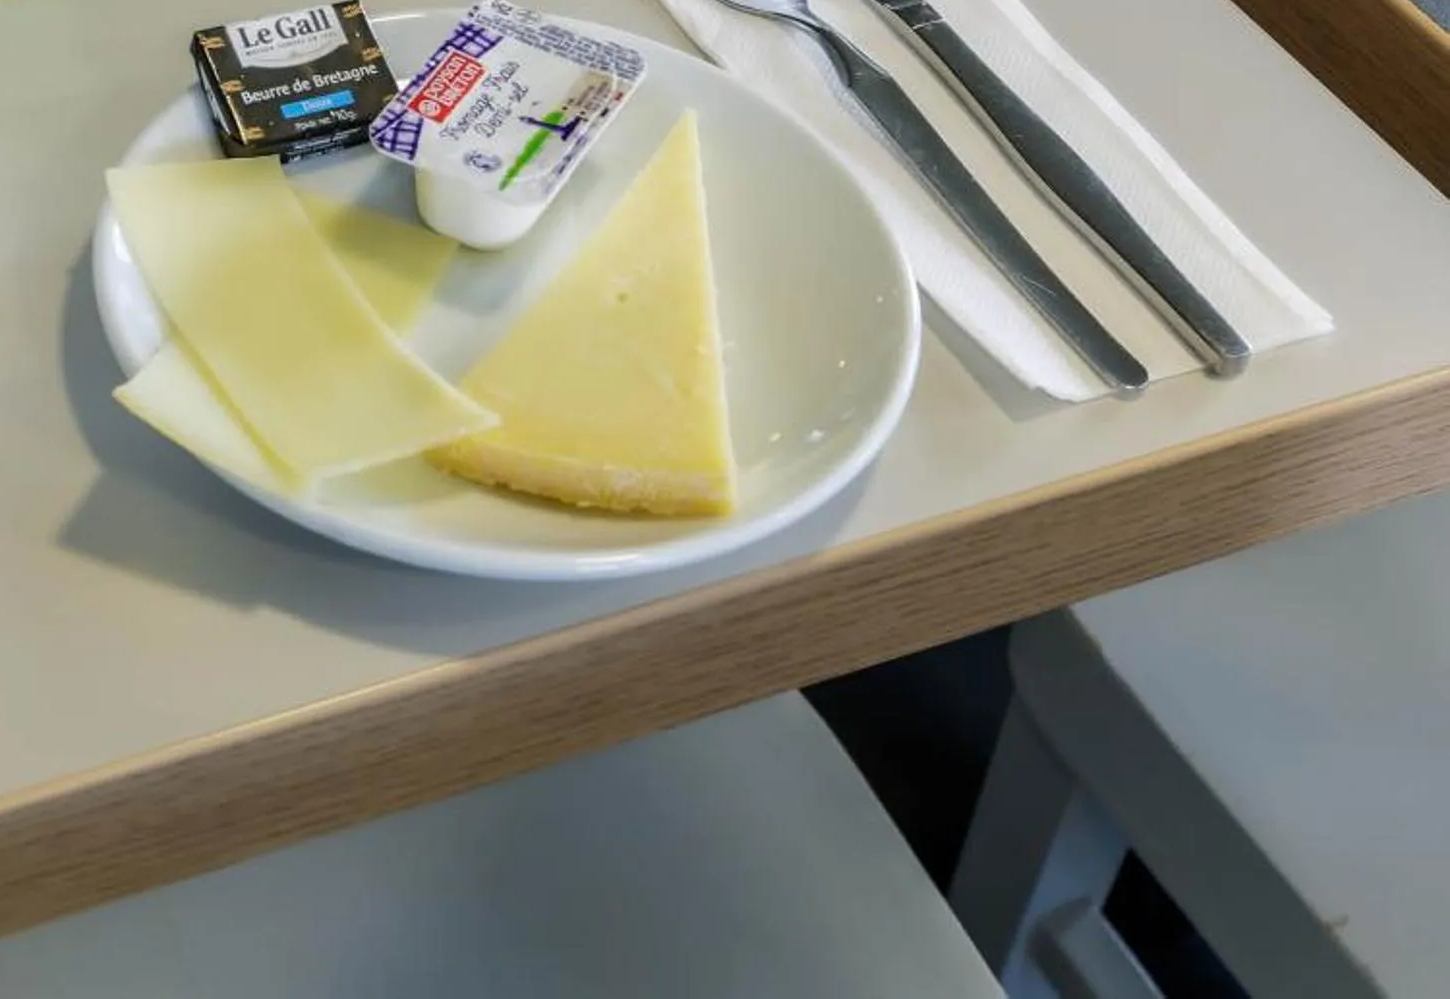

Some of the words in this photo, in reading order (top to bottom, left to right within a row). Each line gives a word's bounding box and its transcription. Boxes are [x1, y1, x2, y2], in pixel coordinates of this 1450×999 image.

[237, 26, 271, 49] Le
[274, 8, 332, 40] Gall
[241, 84, 291, 106] Beurre
[293, 78, 312, 93] de
[312, 64, 379, 88] Bretagne
